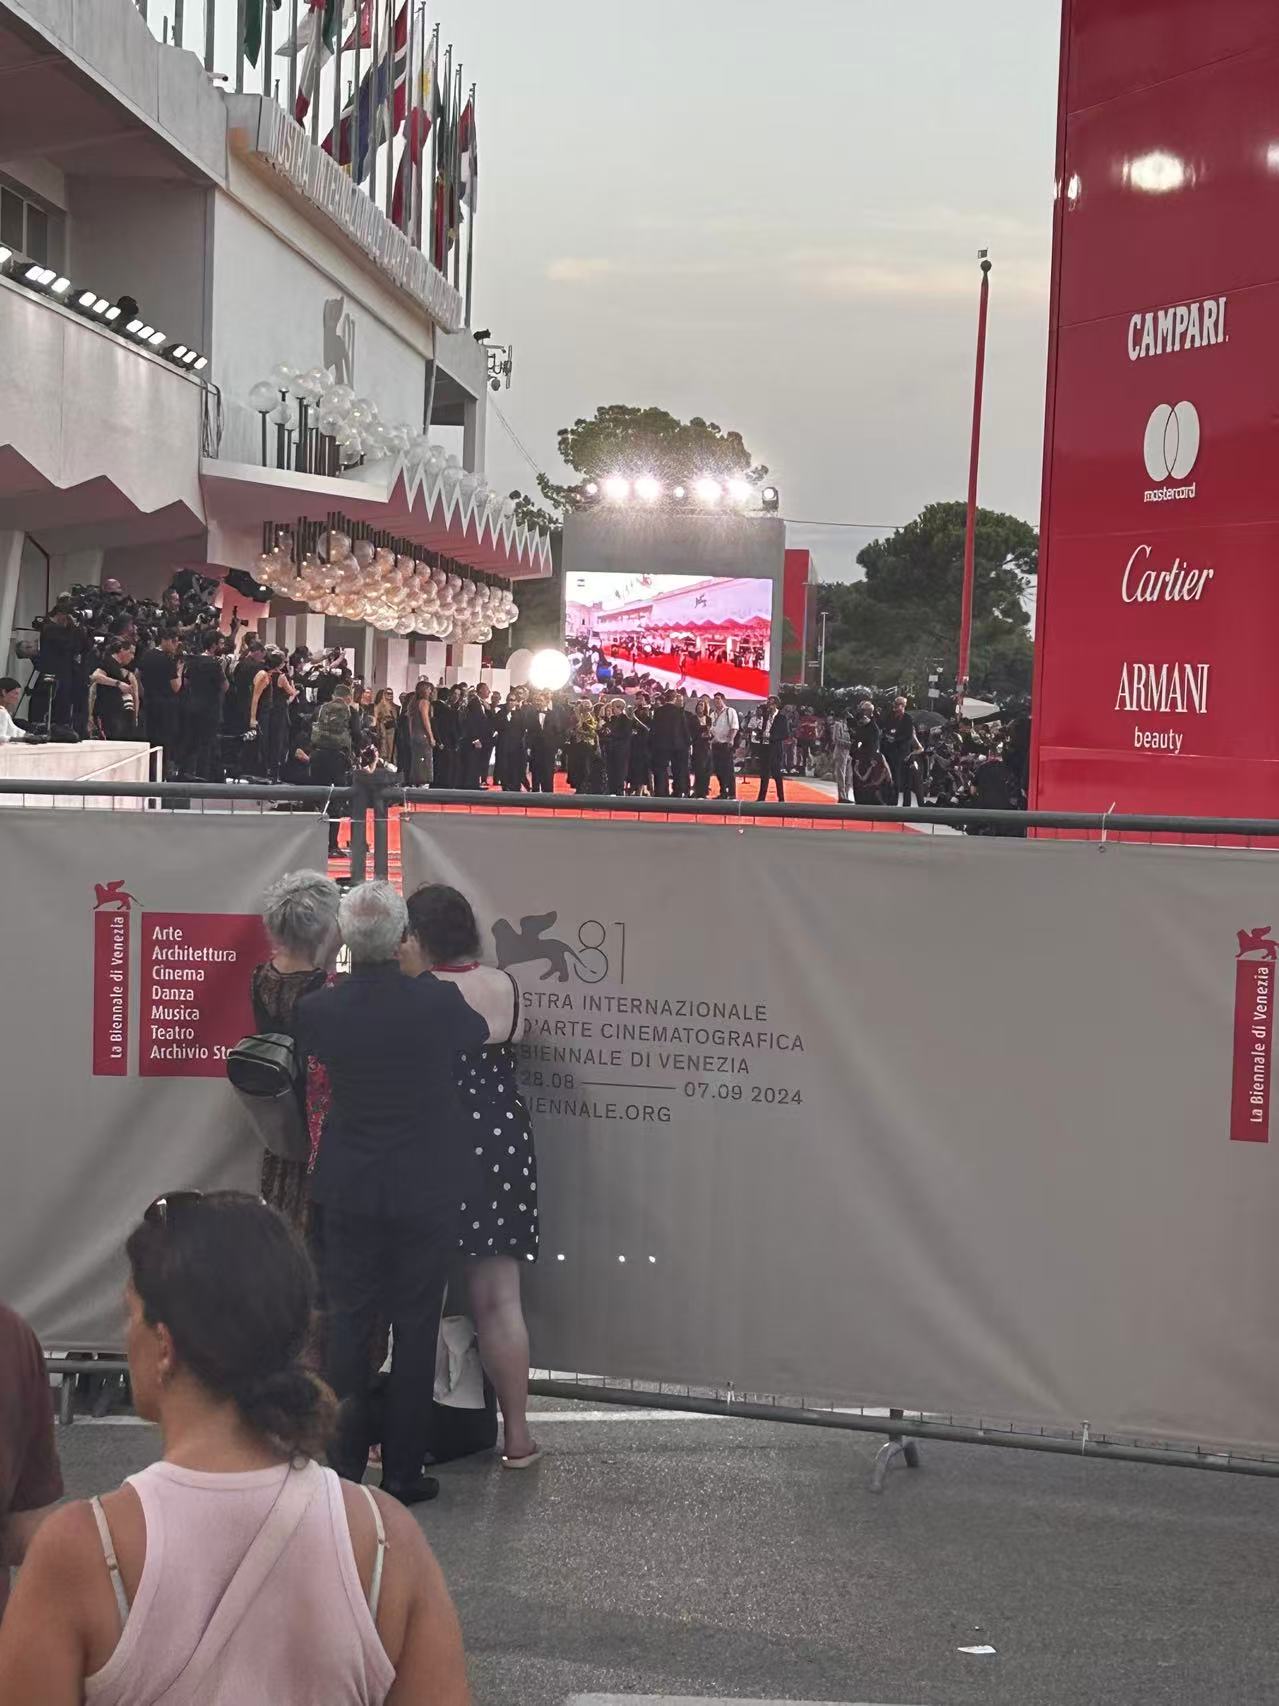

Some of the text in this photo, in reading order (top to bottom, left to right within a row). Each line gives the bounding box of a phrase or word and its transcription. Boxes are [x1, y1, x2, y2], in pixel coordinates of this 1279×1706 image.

[1144, 482, 1196, 502] mastercard
[1121, 545, 1214, 603] Cartier
[1114, 662, 1209, 714] ARMANI
[1134, 725, 1184, 755] beauty
[152, 926, 183, 941] Arte
[152, 945, 237, 962] Architettura
[152, 965, 205, 981] Cinema
[110, 916, 124, 1058] La Biennale di Venezia
[152, 986, 195, 1001] Danza
[151, 1005, 200, 1020] Musica
[522, 992, 768, 1022] STRA INTERNAZIONALE
[151, 1025, 195, 1040] Teatro
[600, 1023, 805, 1052] CINEMATOGRAFICA
[150, 1043, 209, 1059] Archivio
[1250, 967, 1270, 1122] La Biennale di Venezia
[631, 1052, 651, 1068] DI
[659, 1054, 750, 1075] VENEZIA
[684, 1081, 743, 1101] 07.09
[751, 1087, 803, 1105] 2024
[529, 1097, 672, 1123] IENNALE.ORG
